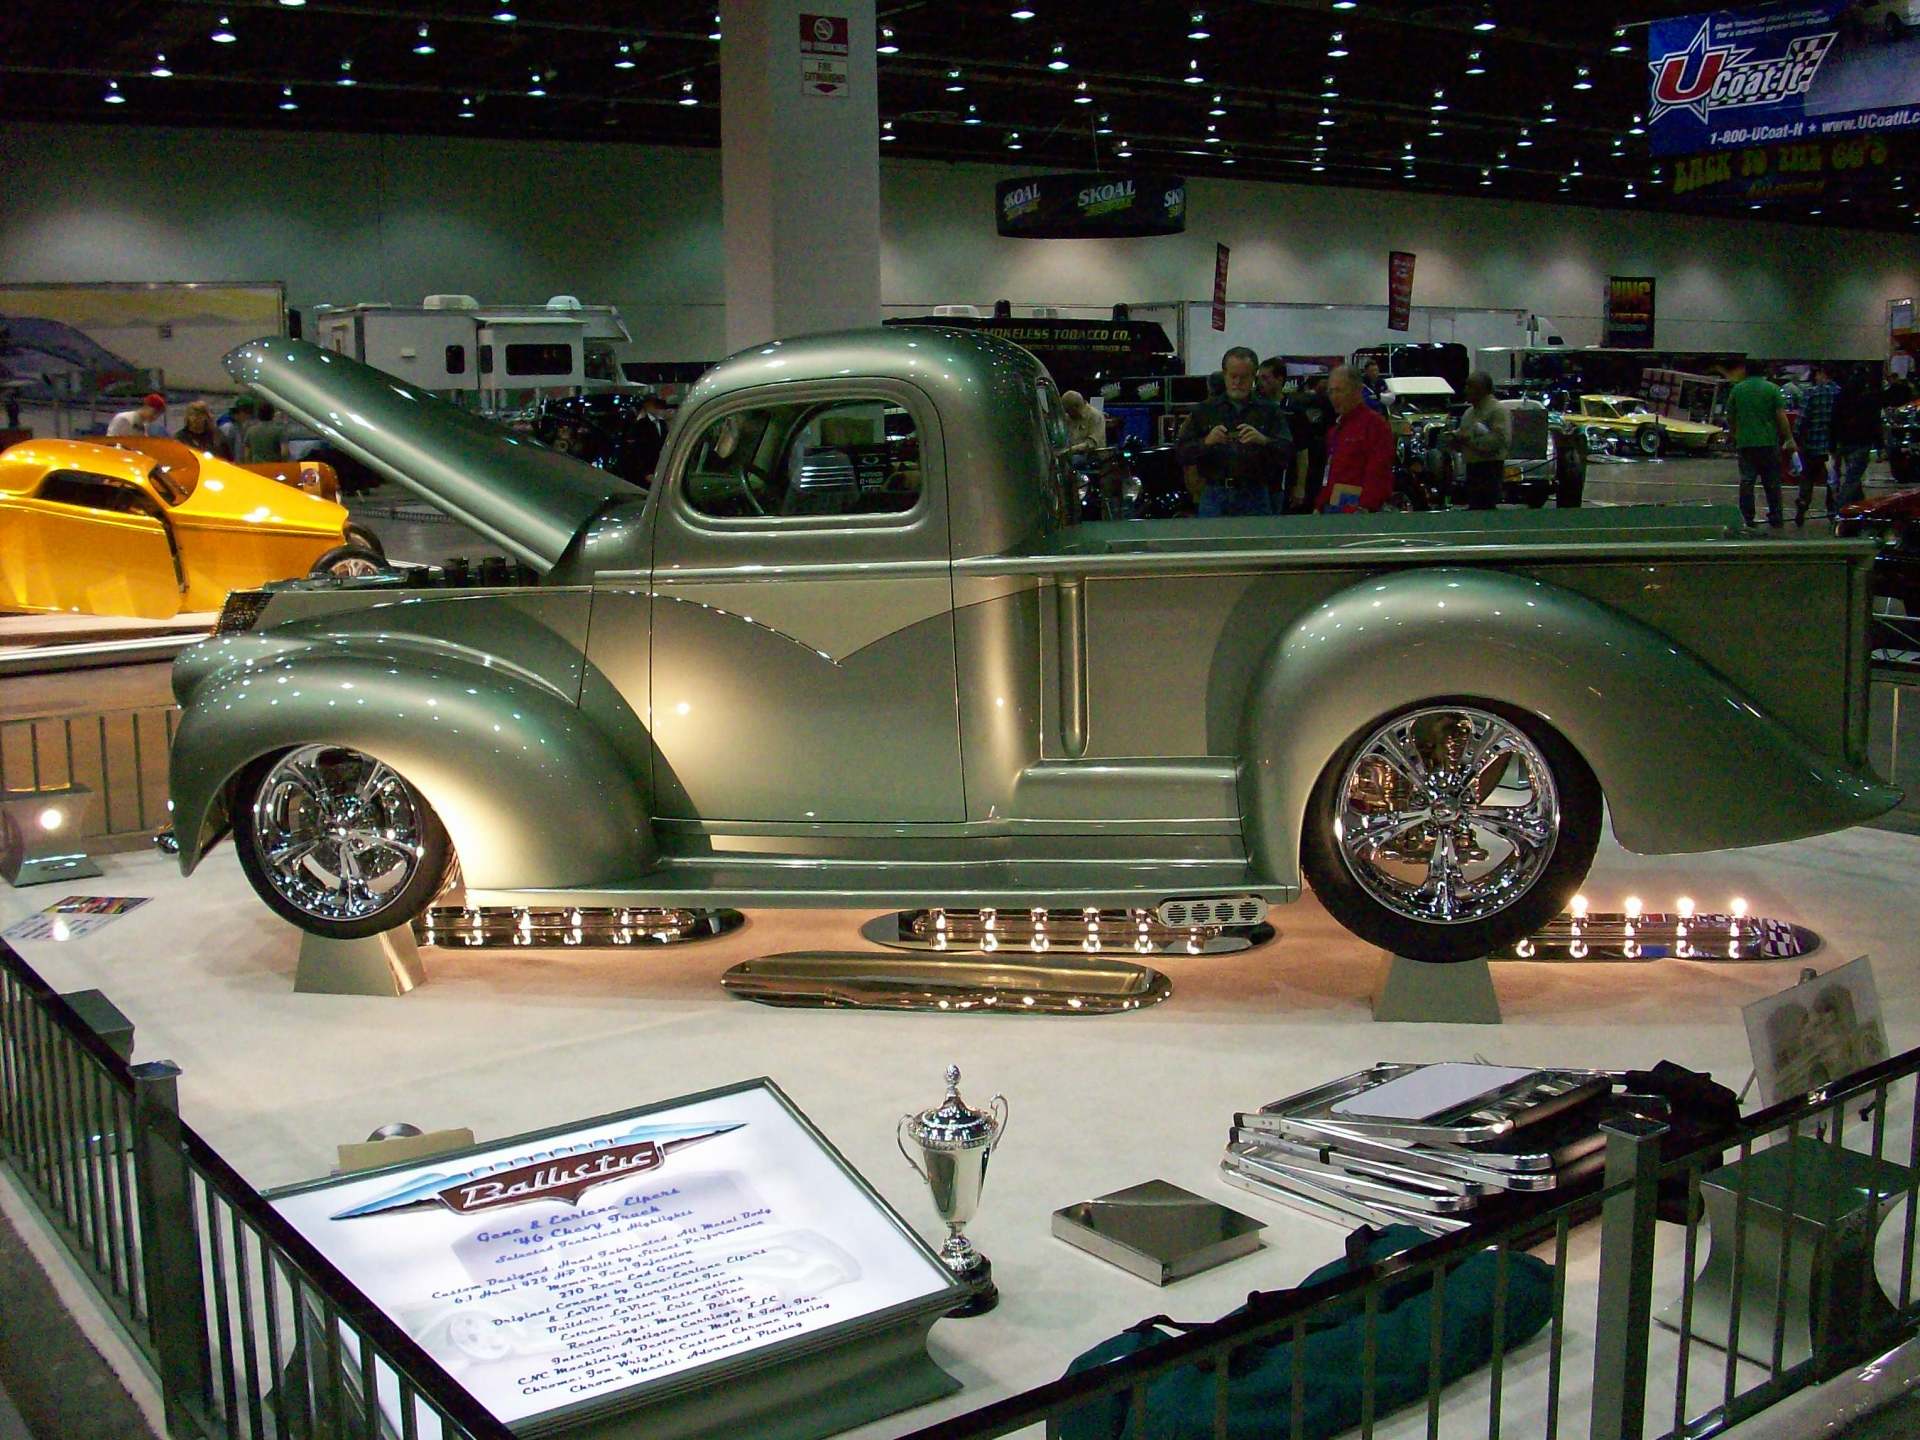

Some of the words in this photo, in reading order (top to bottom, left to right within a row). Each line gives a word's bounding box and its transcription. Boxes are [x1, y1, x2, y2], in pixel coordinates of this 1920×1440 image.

[1077, 180, 1136, 208] SKOAL
[1054, 328, 1109, 341] TOBACCO
[460, 1150, 653, 1209] Ballistic
